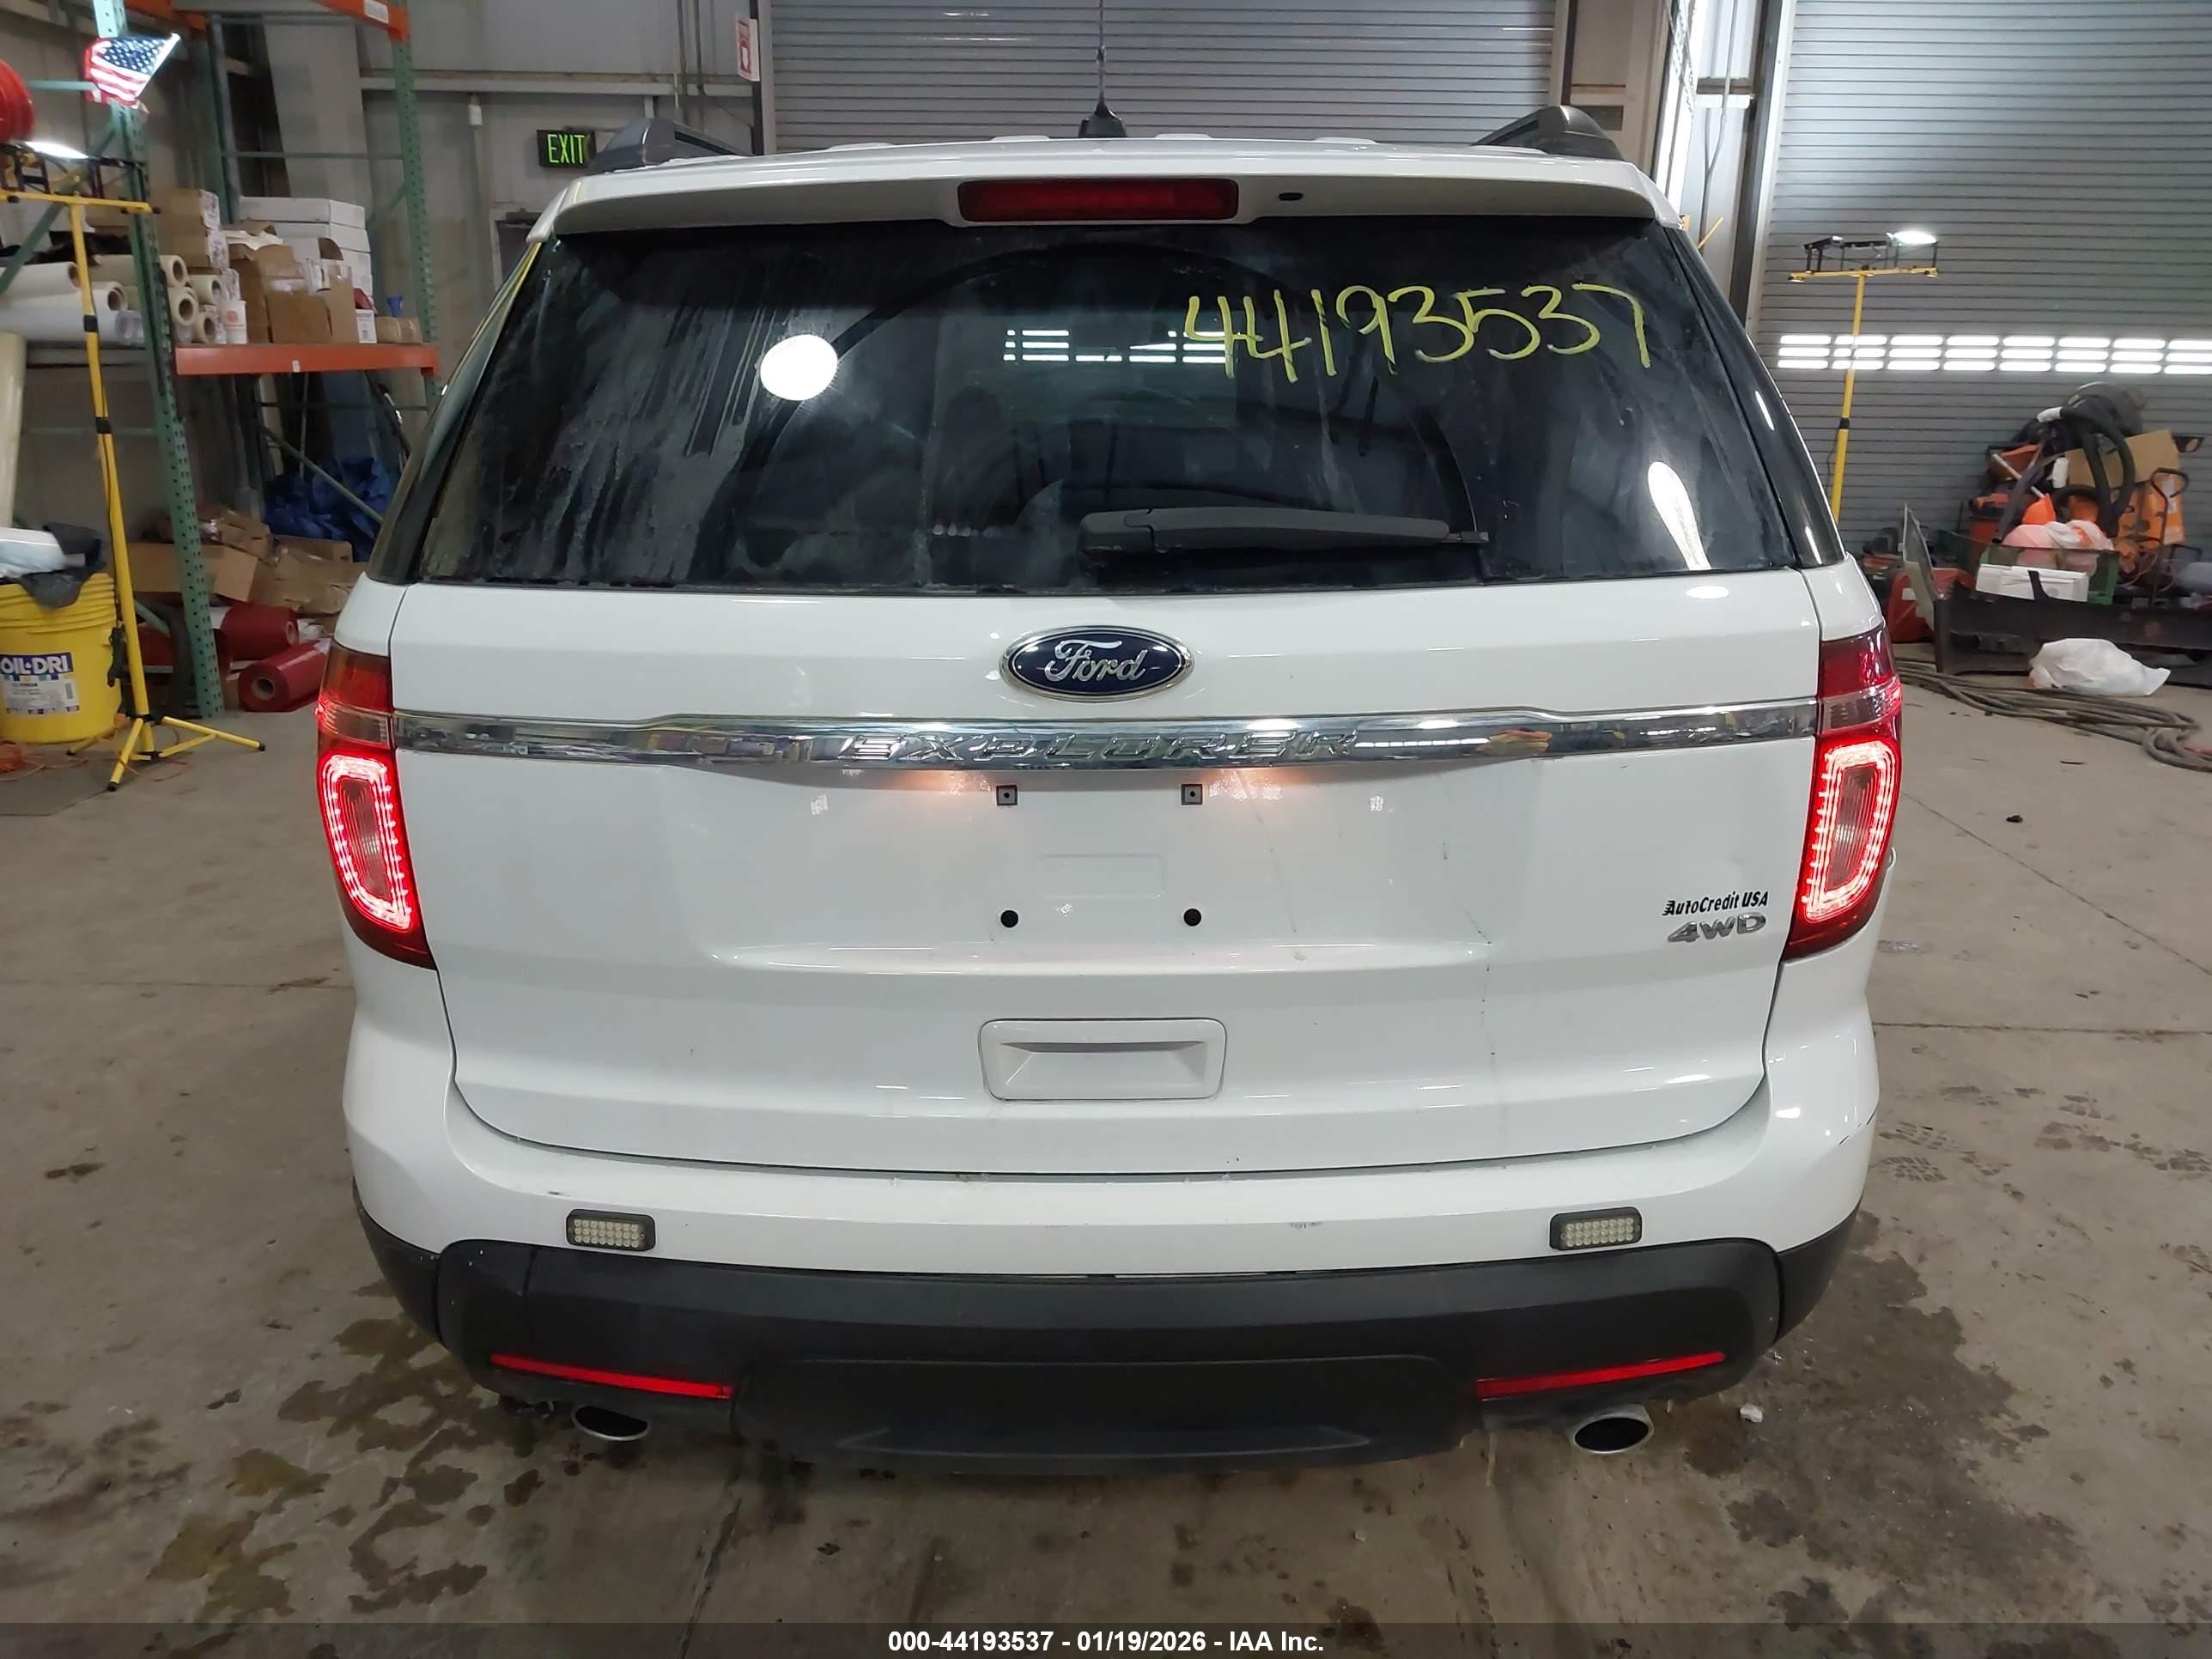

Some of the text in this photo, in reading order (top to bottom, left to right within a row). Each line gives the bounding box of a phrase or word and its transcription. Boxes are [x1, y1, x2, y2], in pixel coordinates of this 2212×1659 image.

[548, 133, 585, 164] EXIT
[1184, 284, 1651, 383] 44193537
[1044, 639, 1148, 681] Ford
[837, 731, 1358, 762] EXPLORER
[1662, 890, 1769, 916] AutoCredit USA
[1668, 912, 1766, 943] 4WD
